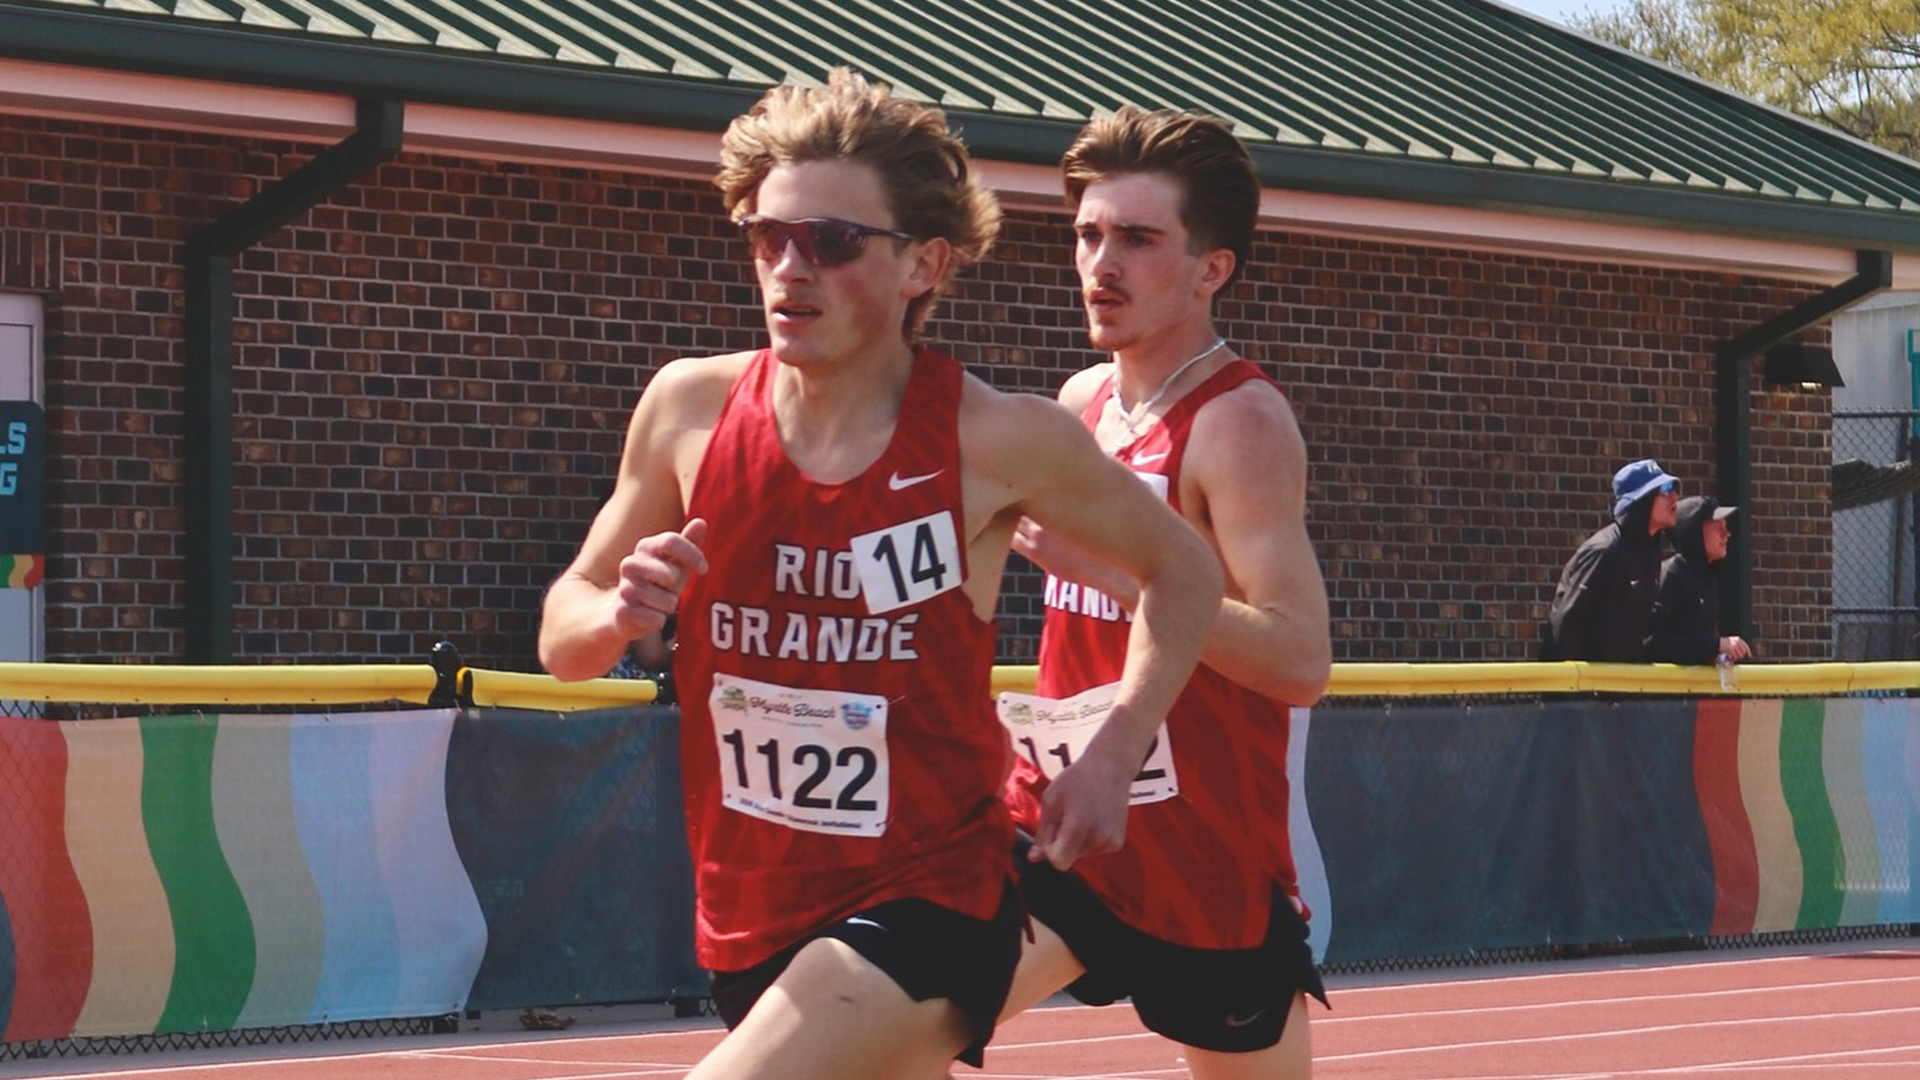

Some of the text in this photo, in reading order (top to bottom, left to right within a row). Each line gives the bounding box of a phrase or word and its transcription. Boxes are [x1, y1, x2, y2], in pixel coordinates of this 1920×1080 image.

[775, 544, 861, 599] RIO
[873, 522, 947, 602] 14
[711, 602, 919, 662] GRANDE
[722, 728, 877, 811] 1122
